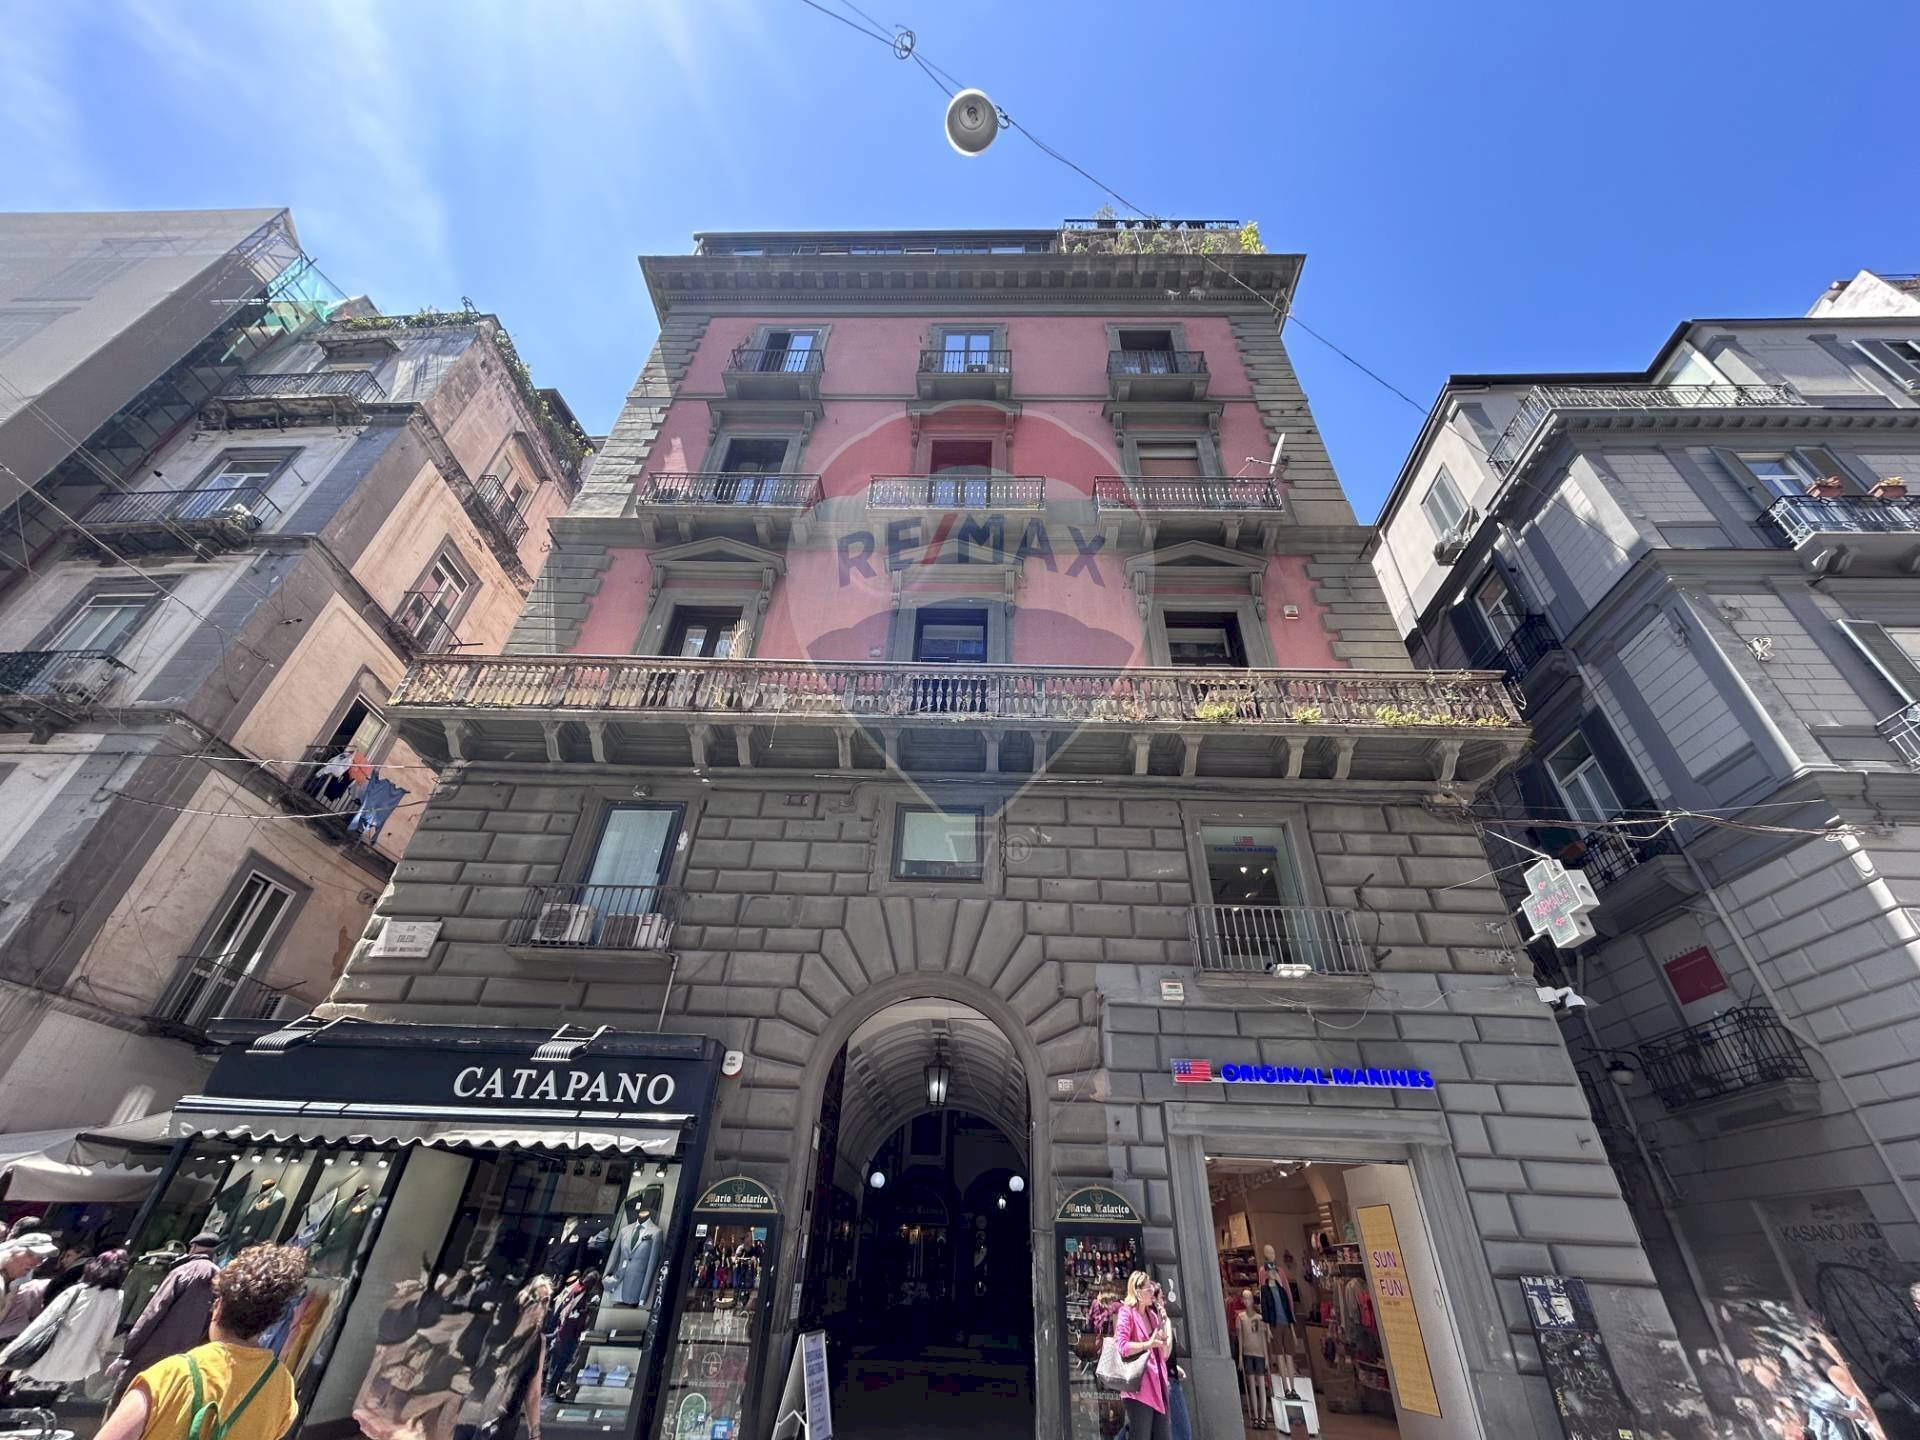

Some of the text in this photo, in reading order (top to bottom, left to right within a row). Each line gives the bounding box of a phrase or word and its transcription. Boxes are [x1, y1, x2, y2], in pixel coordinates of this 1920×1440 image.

[1221, 1063, 1434, 1089] ORIGINAL MARINES
[453, 1067, 676, 1105] CATAPANO
[704, 1193, 732, 1203] Mario
[1065, 1203, 1092, 1213] Mario
[1779, 1222, 1866, 1242] KASANOVA
[1373, 1251, 1397, 1268] SUN
[1380, 1279, 1404, 1297] FUN
